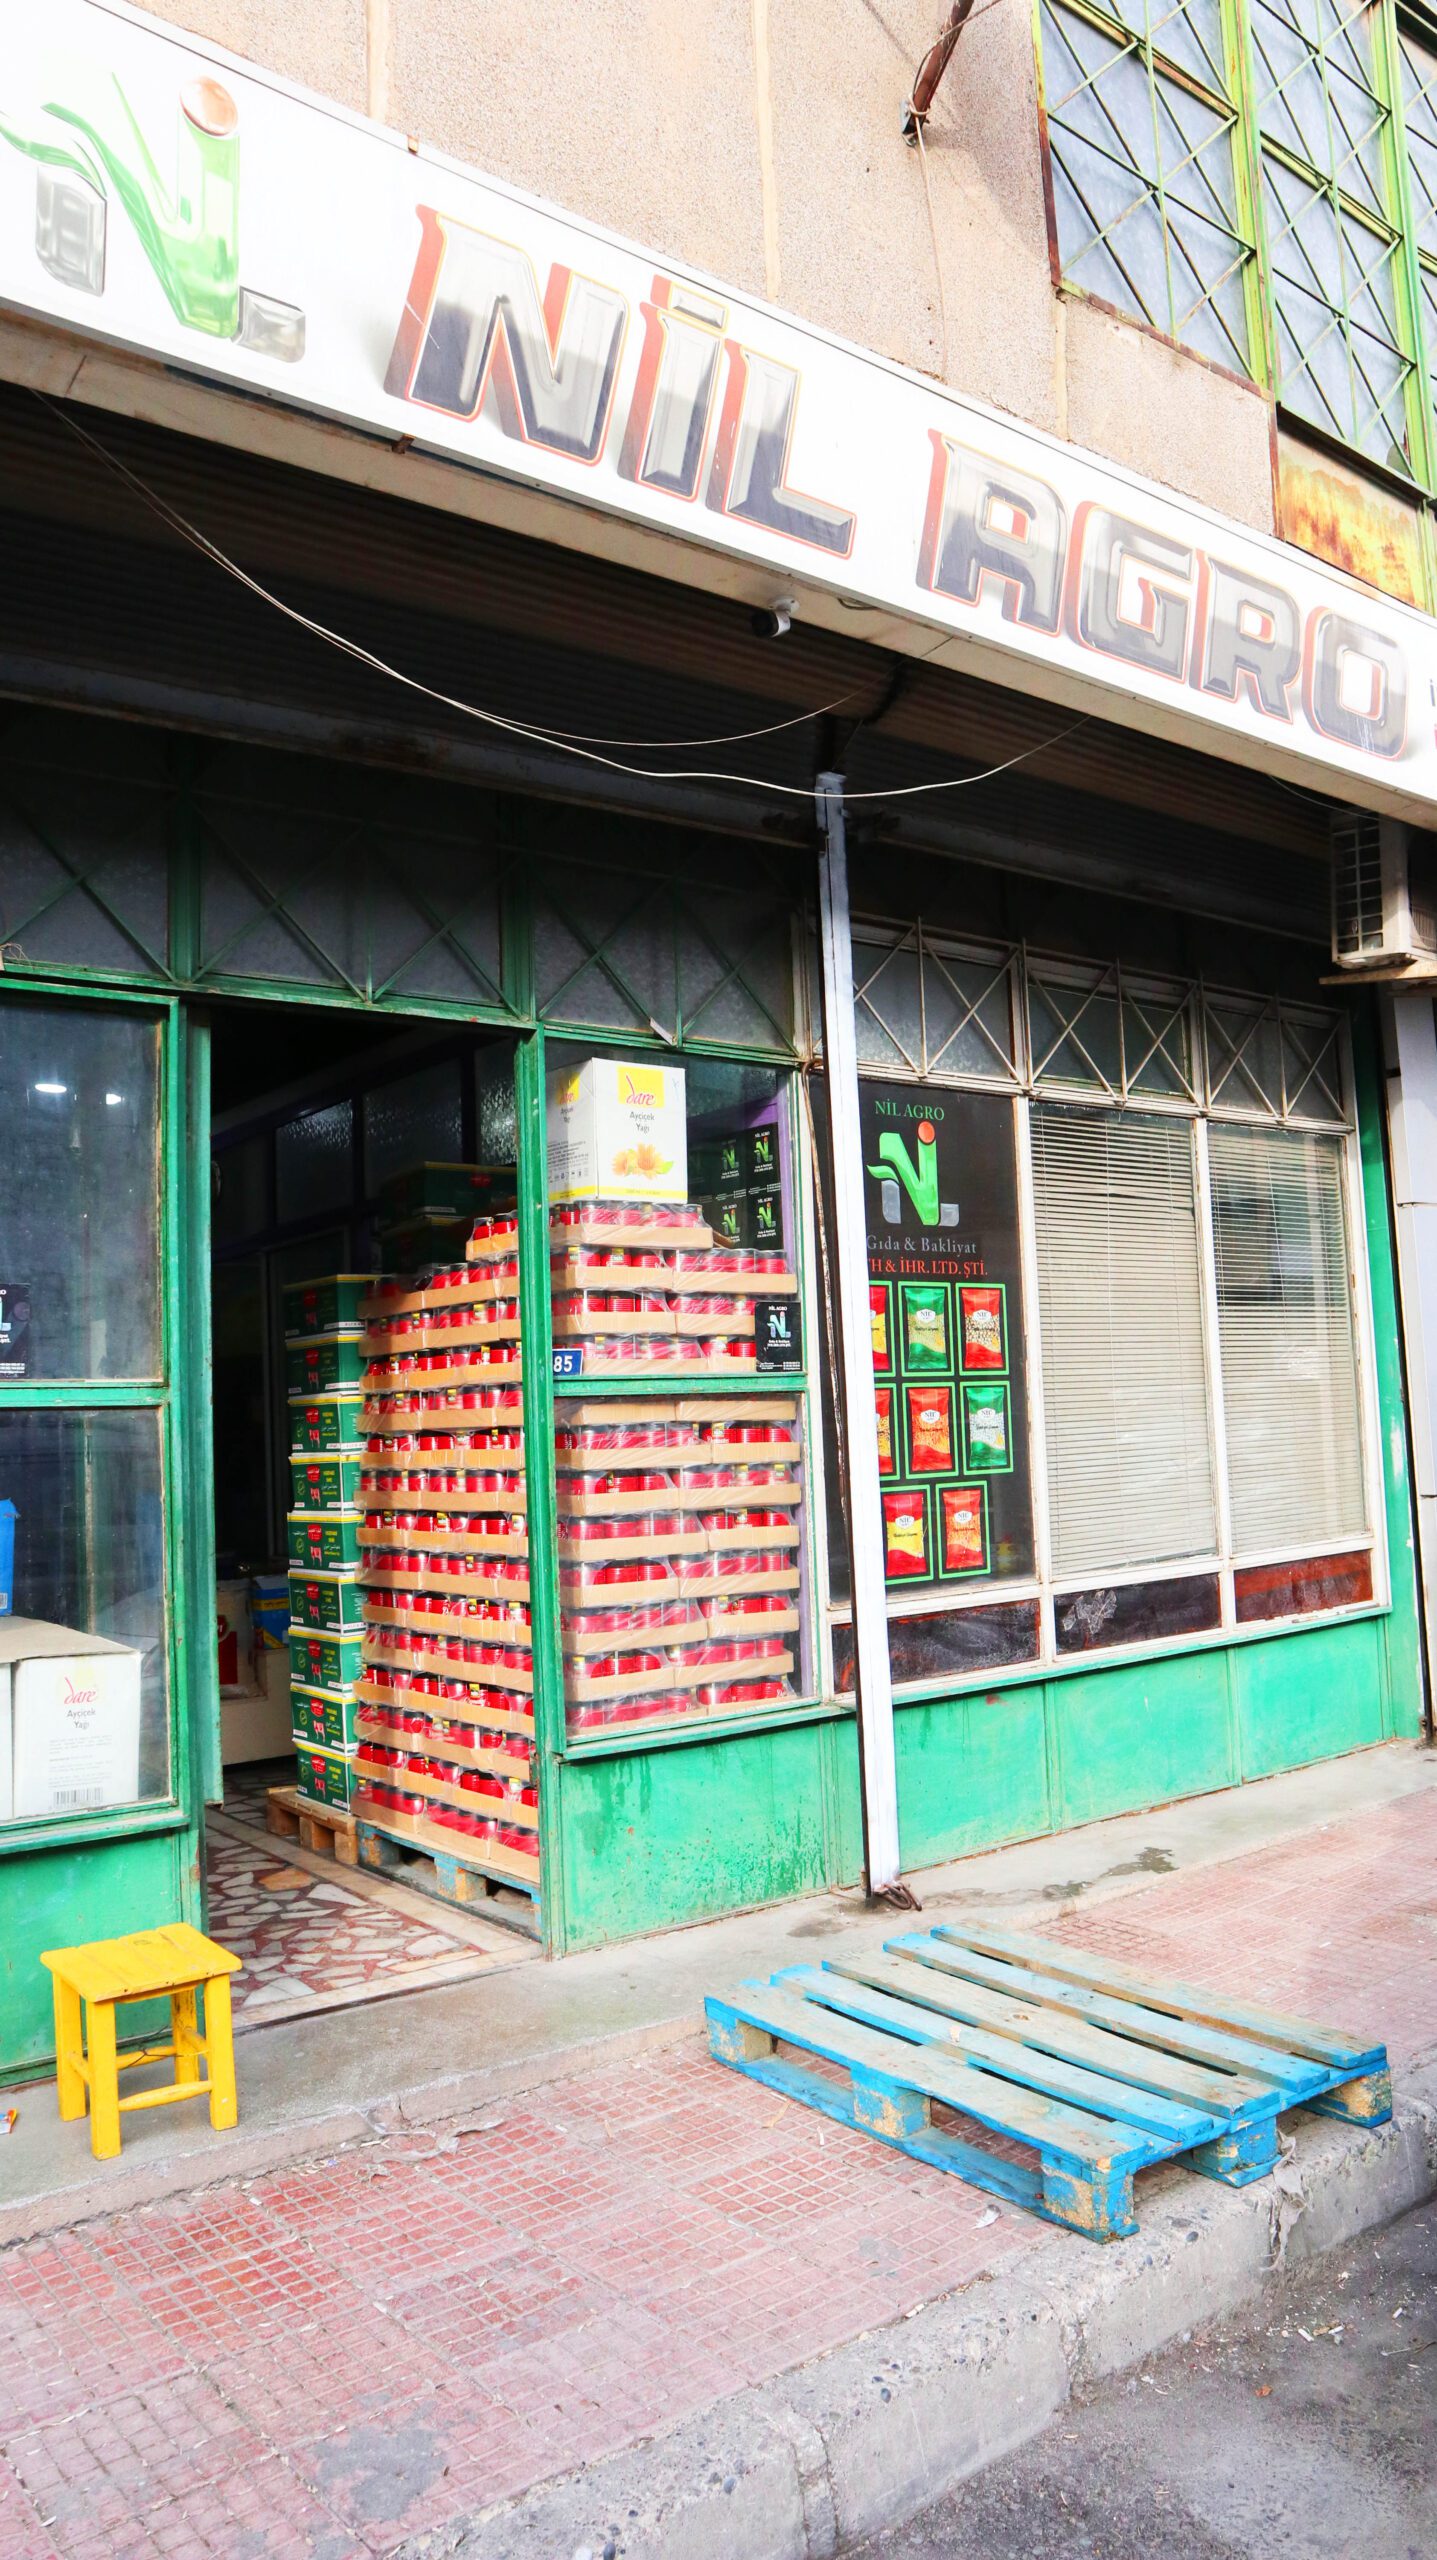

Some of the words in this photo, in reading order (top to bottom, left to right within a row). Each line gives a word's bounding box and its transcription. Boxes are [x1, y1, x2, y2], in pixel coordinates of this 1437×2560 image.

[916, 428, 1406, 760] AGRO
[875, 1098, 901, 1117] NİL
[903, 1103, 945, 1121] AGRO
[867, 1234, 900, 1251] Gıda
[904, 1236, 916, 1252] &
[921, 1237, 976, 1258] Bakliyat
[885, 1260, 896, 1273] &
[900, 1256, 930, 1274] İHR.
[932, 1260, 961, 1275] LTD.
[963, 1260, 988, 1279] ŞTİ.
[553, 1355, 573, 1373] 85
